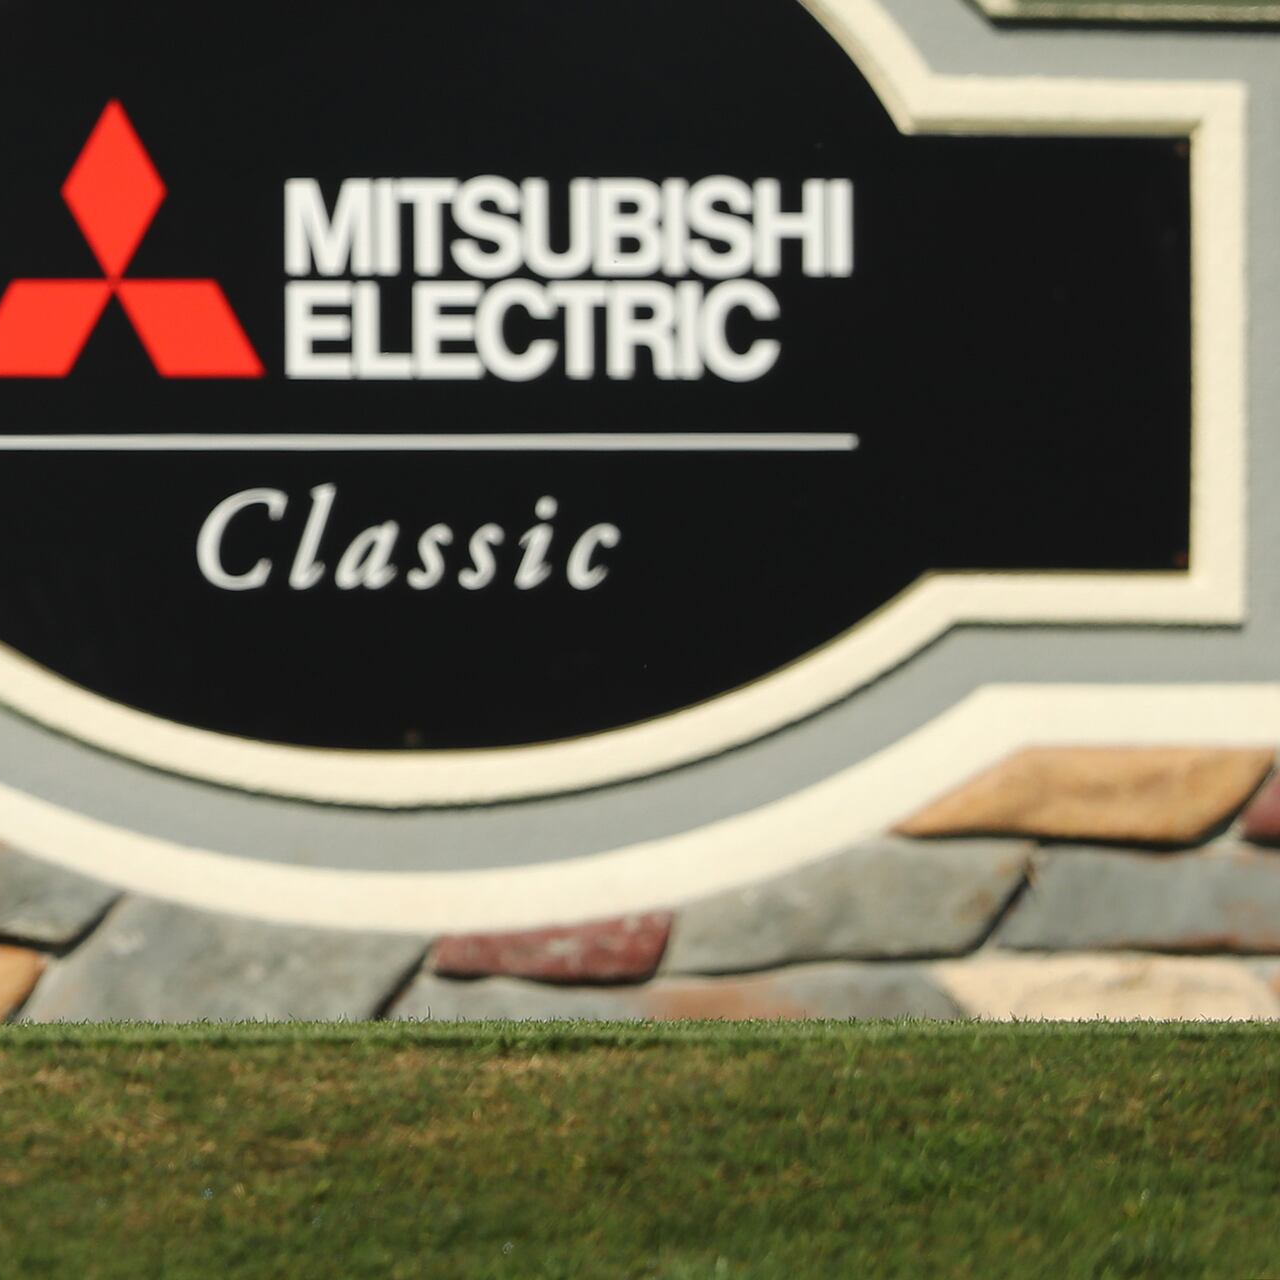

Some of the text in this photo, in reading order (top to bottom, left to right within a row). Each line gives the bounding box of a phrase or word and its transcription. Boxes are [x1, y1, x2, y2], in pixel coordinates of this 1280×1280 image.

[284, 174, 854, 278] MITSUBISHI
[284, 280, 781, 382] ELECTRIC
[195, 482, 622, 591] Classic
